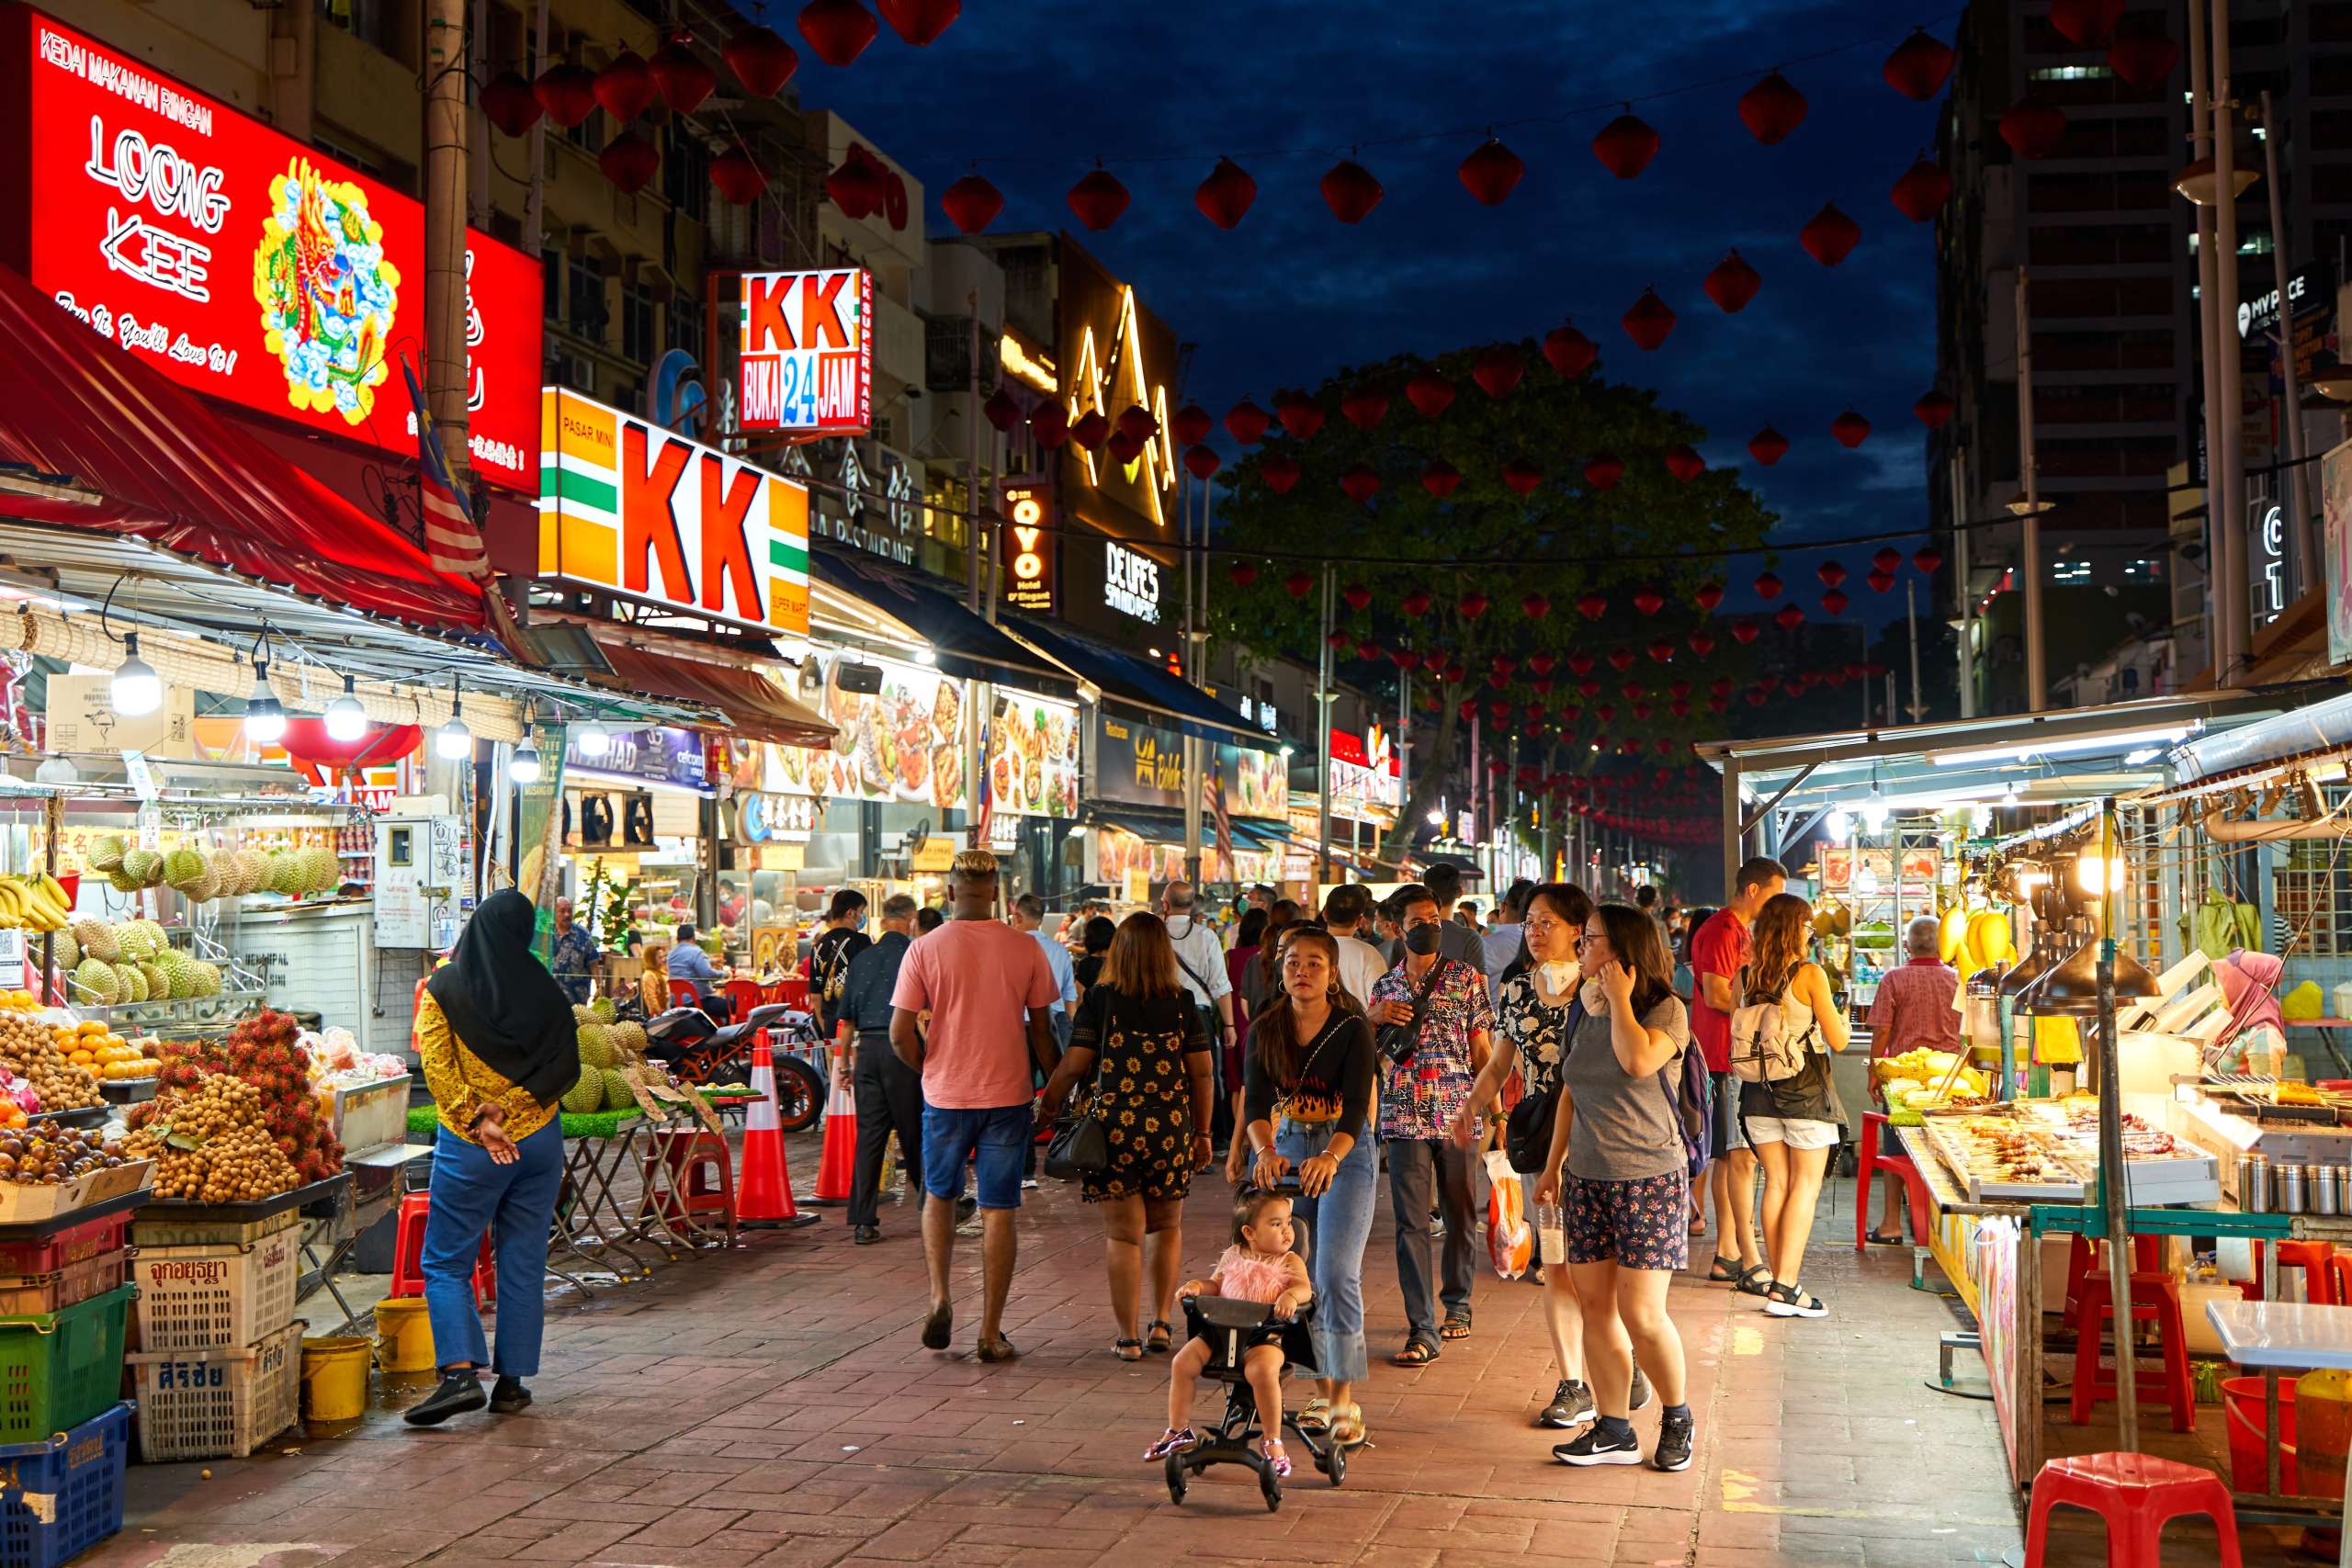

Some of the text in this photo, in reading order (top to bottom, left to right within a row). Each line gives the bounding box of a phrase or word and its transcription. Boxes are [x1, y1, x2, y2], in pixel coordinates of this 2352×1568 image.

[40, 28, 212, 138] KEDAI MAKANAN RINGAN
[85, 115, 231, 234] LOONG
[99, 207, 211, 303] KEE
[751, 273, 851, 352] KK
[2252, 276, 2305, 319] MYPCE
[118, 313, 169, 350] You'll
[167, 333, 207, 366] Love
[861, 303, 871, 425] SUPERMART
[743, 355, 855, 424] BUKA 24 JAM
[563, 416, 615, 449] PASAR MINI
[623, 420, 765, 622] KK
[1013, 499, 1042, 579] OYO
[772, 594, 790, 611] SUPER
[1017, 581, 1041, 590] Hotel
[150, 1260, 228, 1286] จุกอยุธยา
[204, 1277, 220, 1285] 63
[159, 1361, 223, 1390] ศิริชัย
